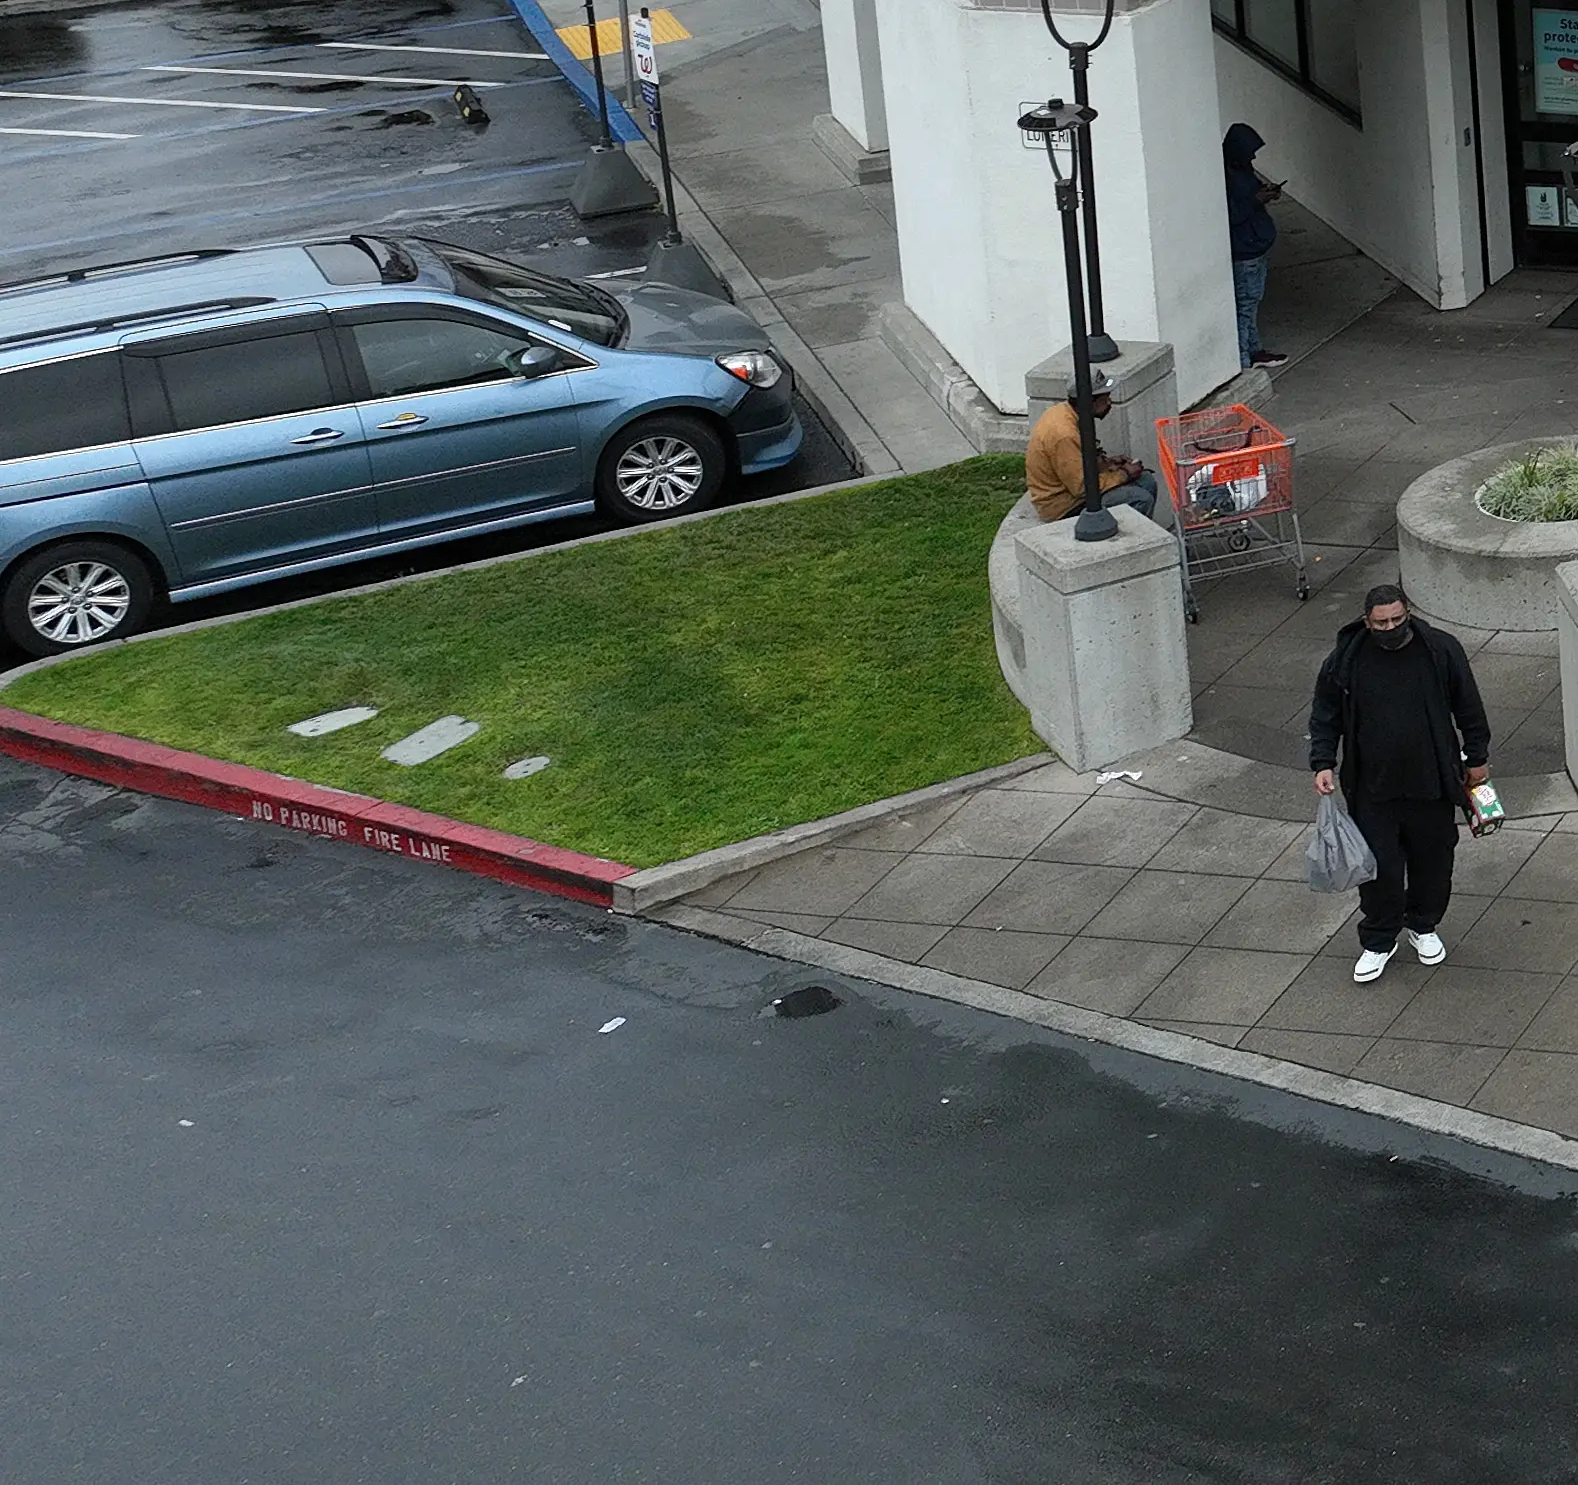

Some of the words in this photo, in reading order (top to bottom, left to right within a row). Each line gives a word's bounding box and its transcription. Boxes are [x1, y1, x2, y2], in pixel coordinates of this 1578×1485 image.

[252, 800, 273, 821] NO
[280, 807, 348, 837] PARKING
[363, 826, 402, 852] FIRE
[408, 837, 452, 862] LANE
